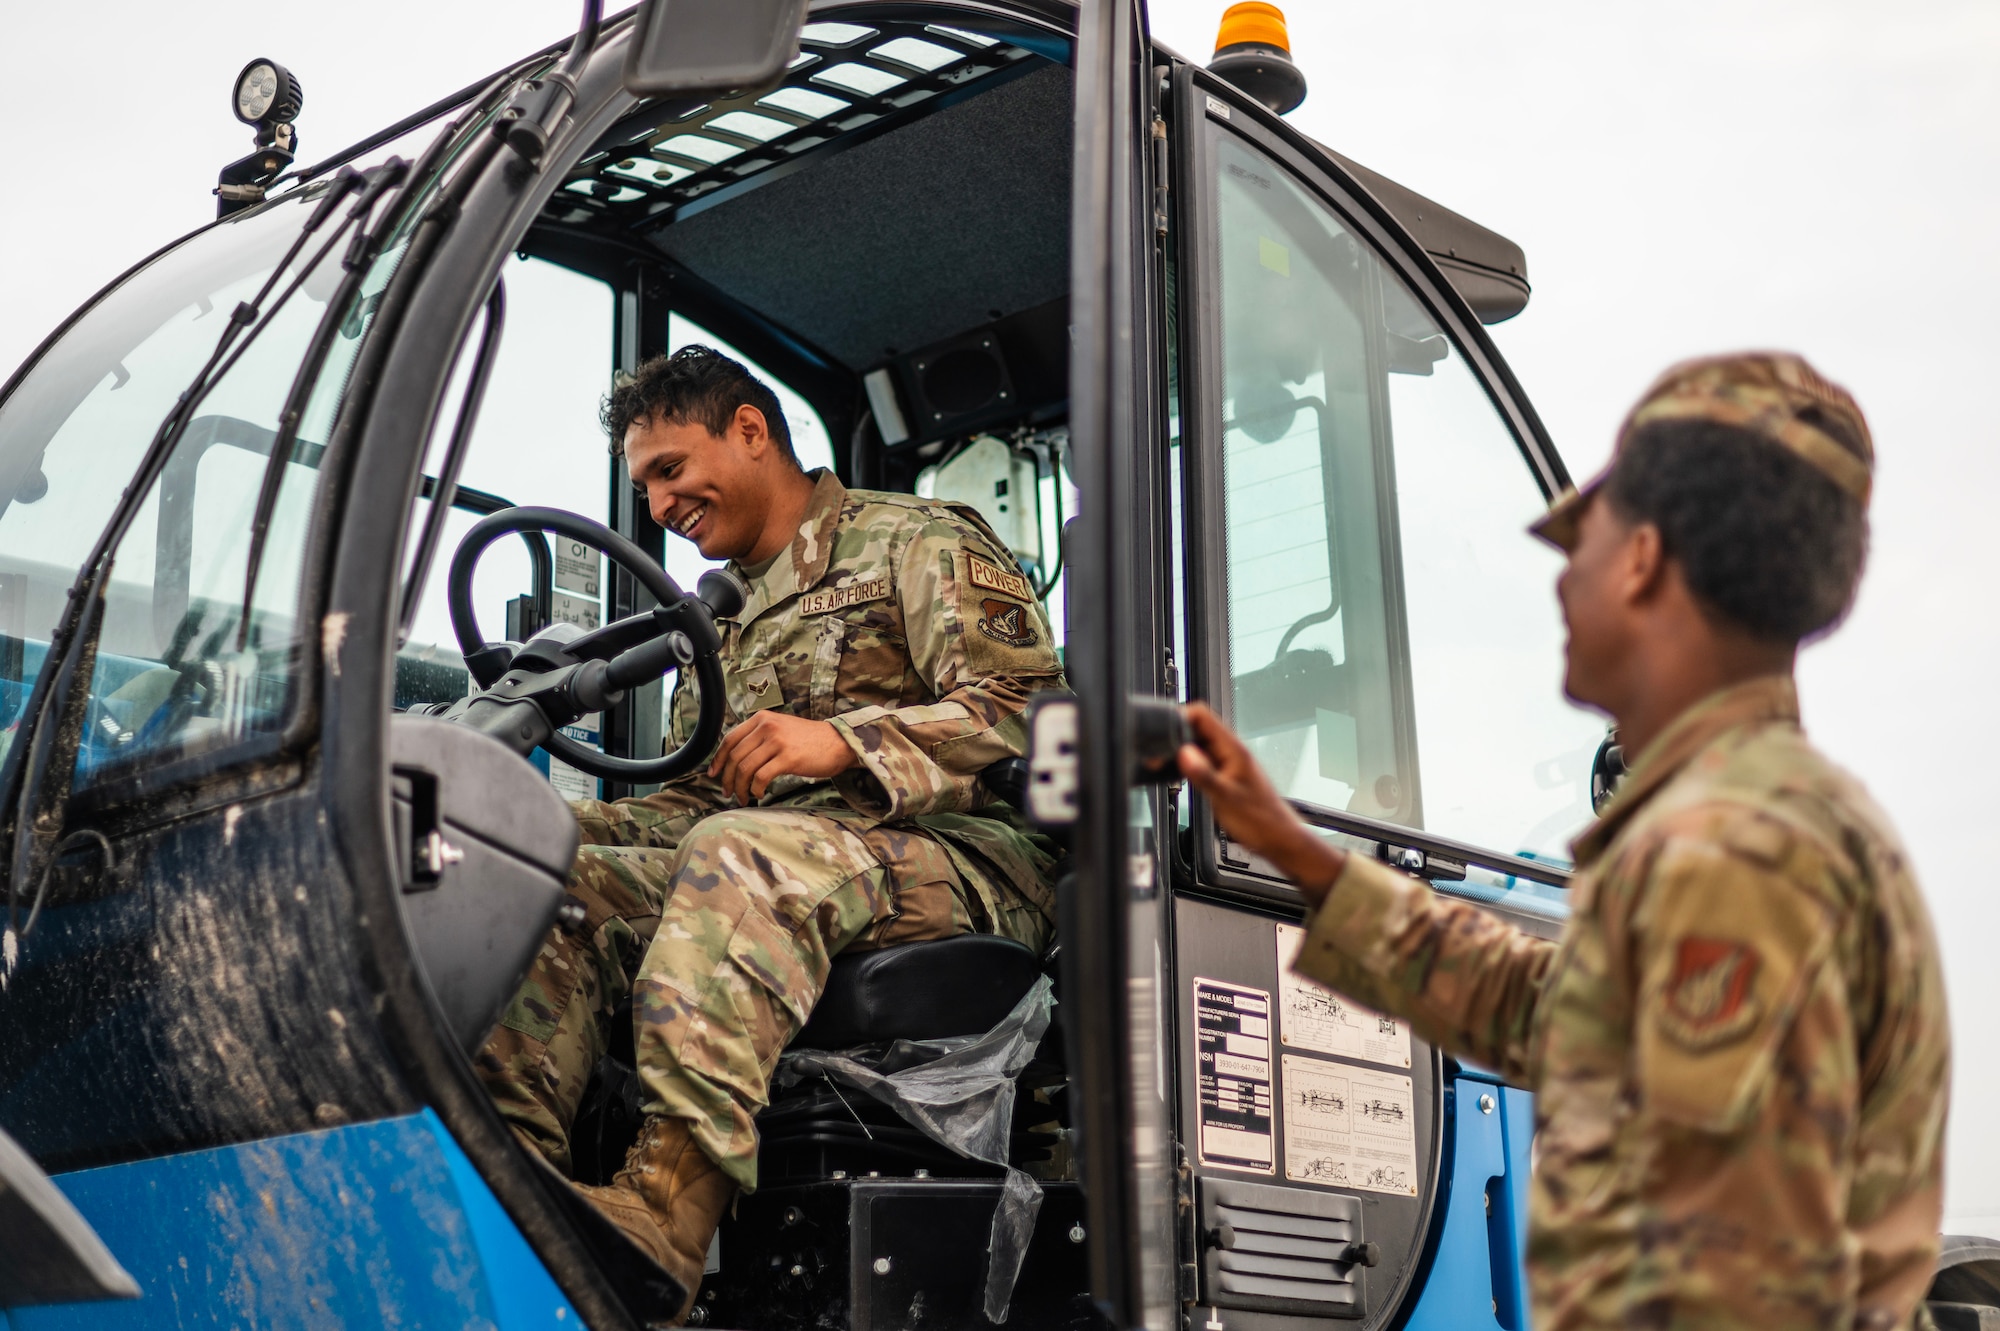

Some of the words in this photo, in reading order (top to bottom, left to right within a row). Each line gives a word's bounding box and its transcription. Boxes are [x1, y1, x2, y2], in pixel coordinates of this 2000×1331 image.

[974, 561, 1026, 596] POWER
[802, 595, 826, 614] U.S.
[827, 589, 844, 609] AIR
[846, 579, 887, 605] FORCE
[562, 726, 589, 741] NOTICE
[1197, 991, 1211, 1000] MAKE
[1216, 995, 1233, 1004] MODEL
[1199, 1028, 1226, 1037] REGISTRATION
[1199, 1034, 1216, 1042] NUMBER
[1199, 1052, 1213, 1062] NSN
[1219, 1060, 1264, 1073] 3930-01-647-7904
